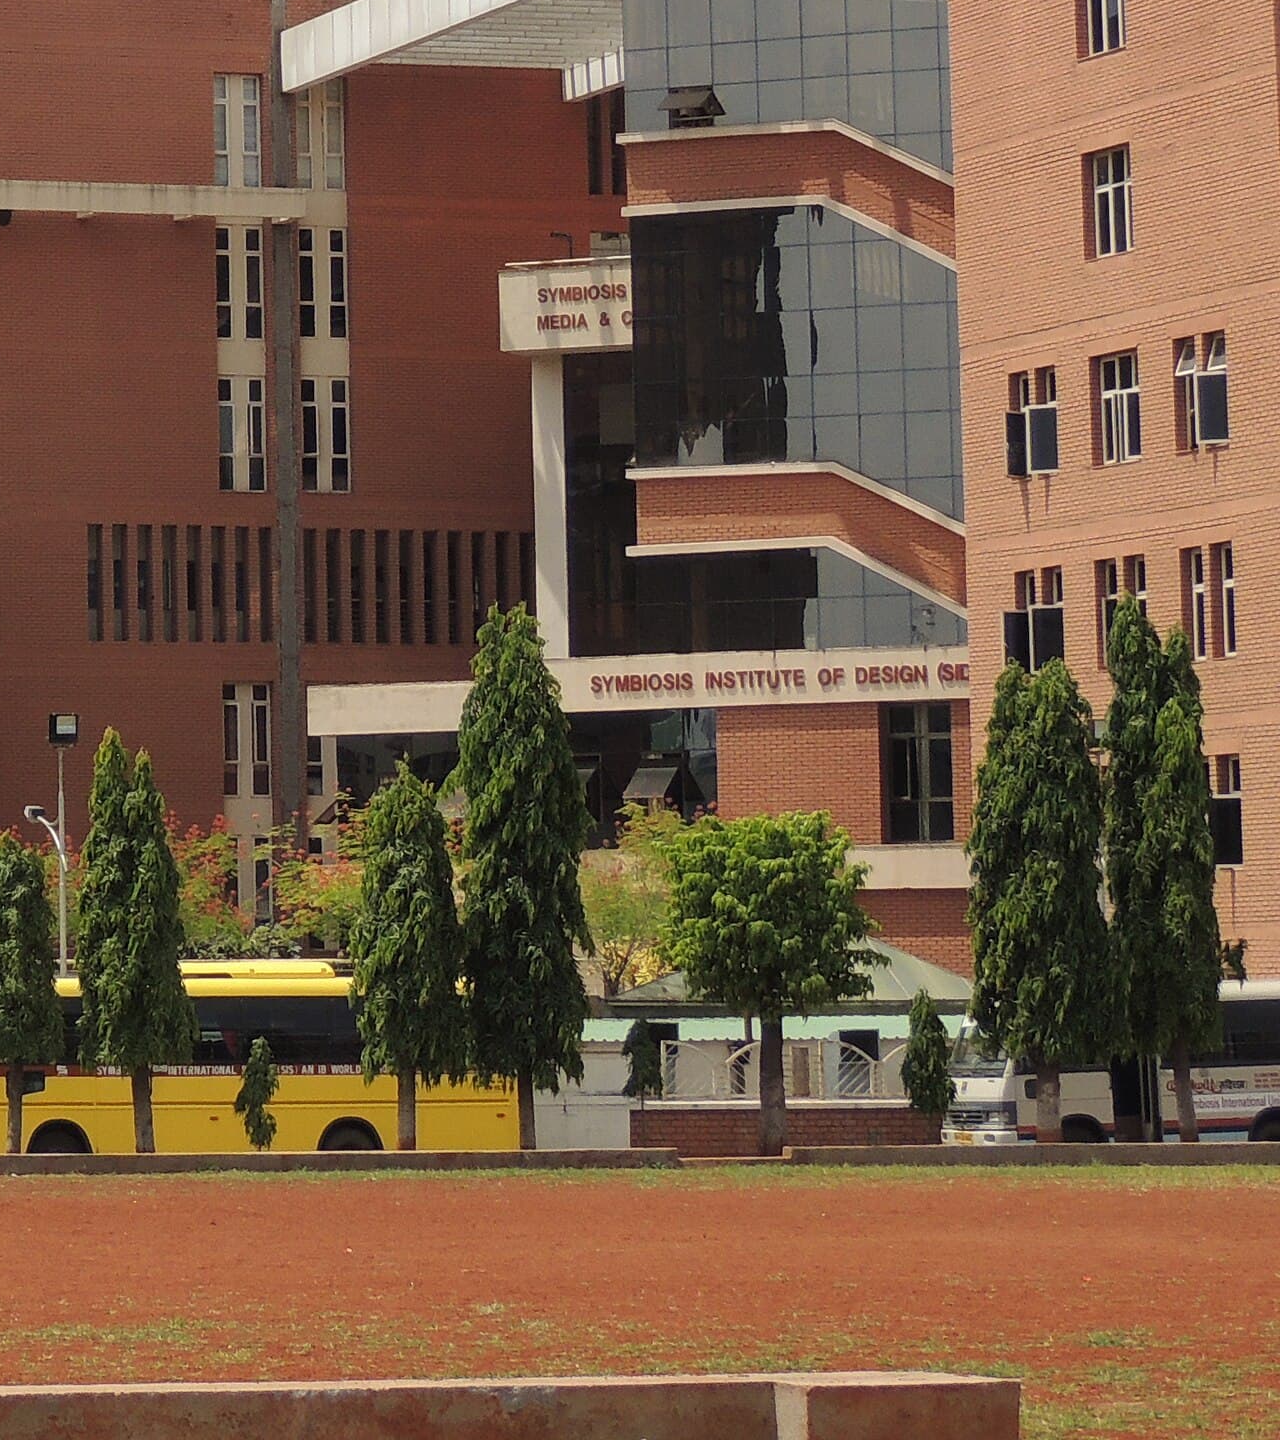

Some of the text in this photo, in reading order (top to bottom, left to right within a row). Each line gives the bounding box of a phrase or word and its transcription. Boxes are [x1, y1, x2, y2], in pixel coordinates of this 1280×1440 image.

[537, 283, 627, 304] SYMBIOSIS
[536, 312, 589, 331] MEDIA
[599, 311, 611, 327] &
[590, 672, 693, 693] SYMBIOSIS
[705, 668, 806, 690] INSTITUTE
[817, 667, 845, 686] OF
[854, 664, 929, 685] DESIGN
[167, 1064, 237, 1076] INTERNATIONAL
[301, 1064, 314, 1074] AN
[331, 1064, 362, 1074] WORLD
